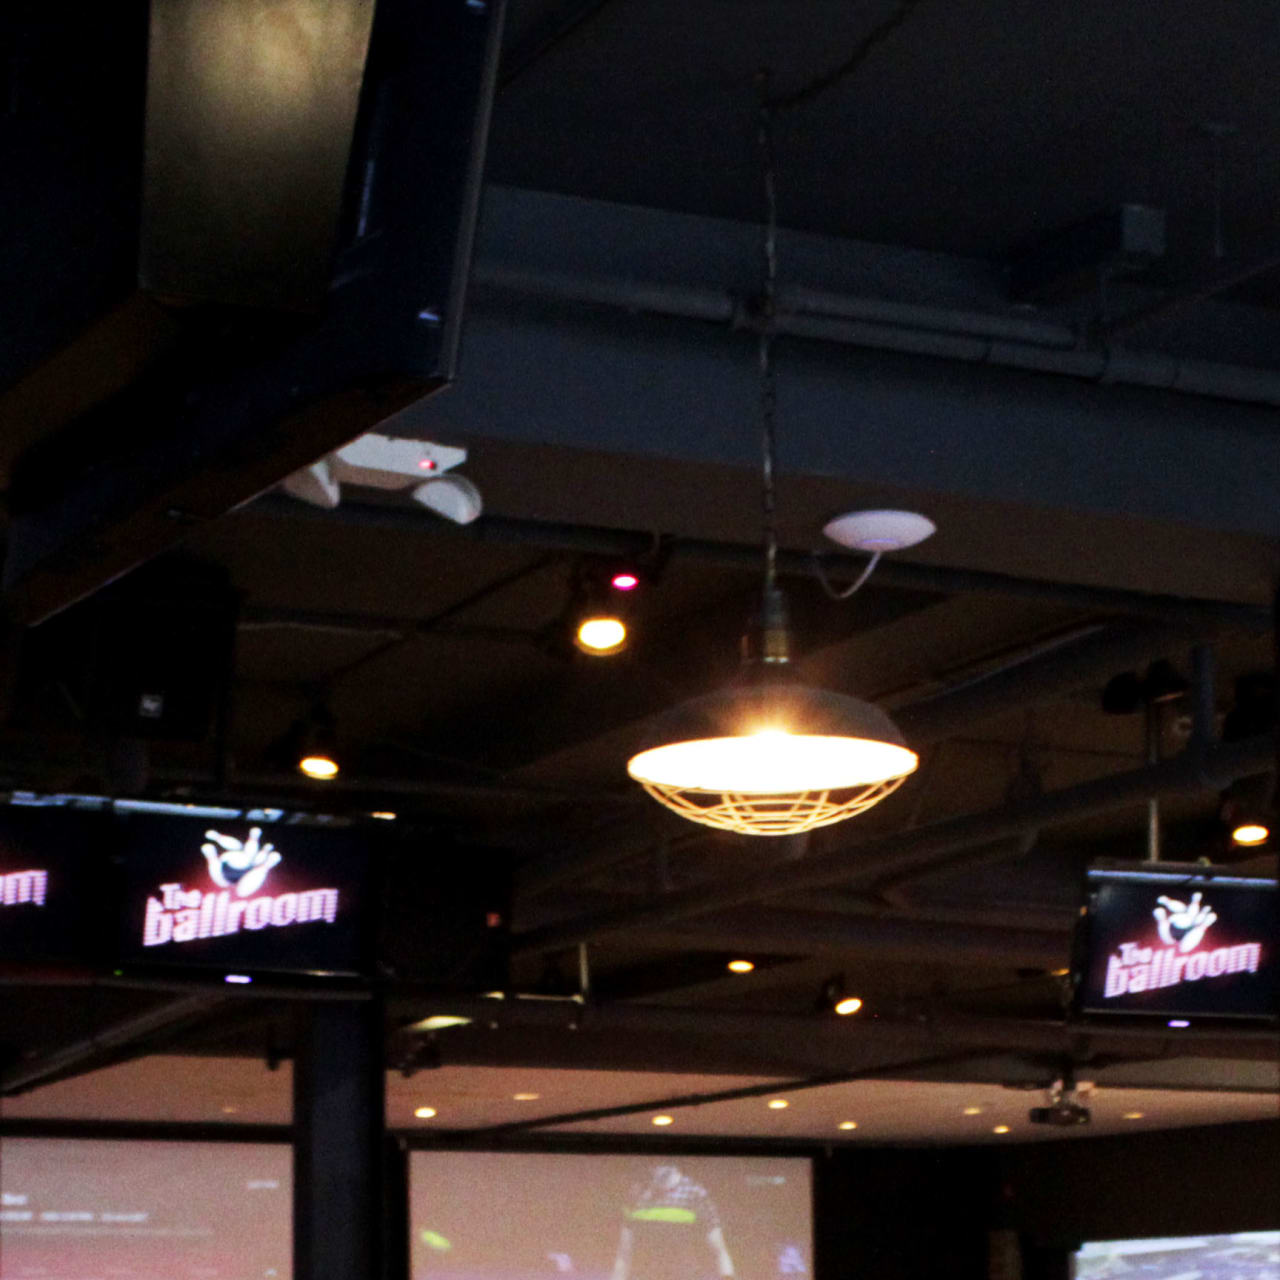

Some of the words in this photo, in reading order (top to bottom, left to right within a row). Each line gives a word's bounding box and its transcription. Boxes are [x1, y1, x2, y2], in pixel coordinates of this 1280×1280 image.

[143, 888, 338, 946] ballroom
[160, 883, 202, 910] The
[1104, 943, 1262, 998] ballroom
[1119, 942, 1153, 966] The
